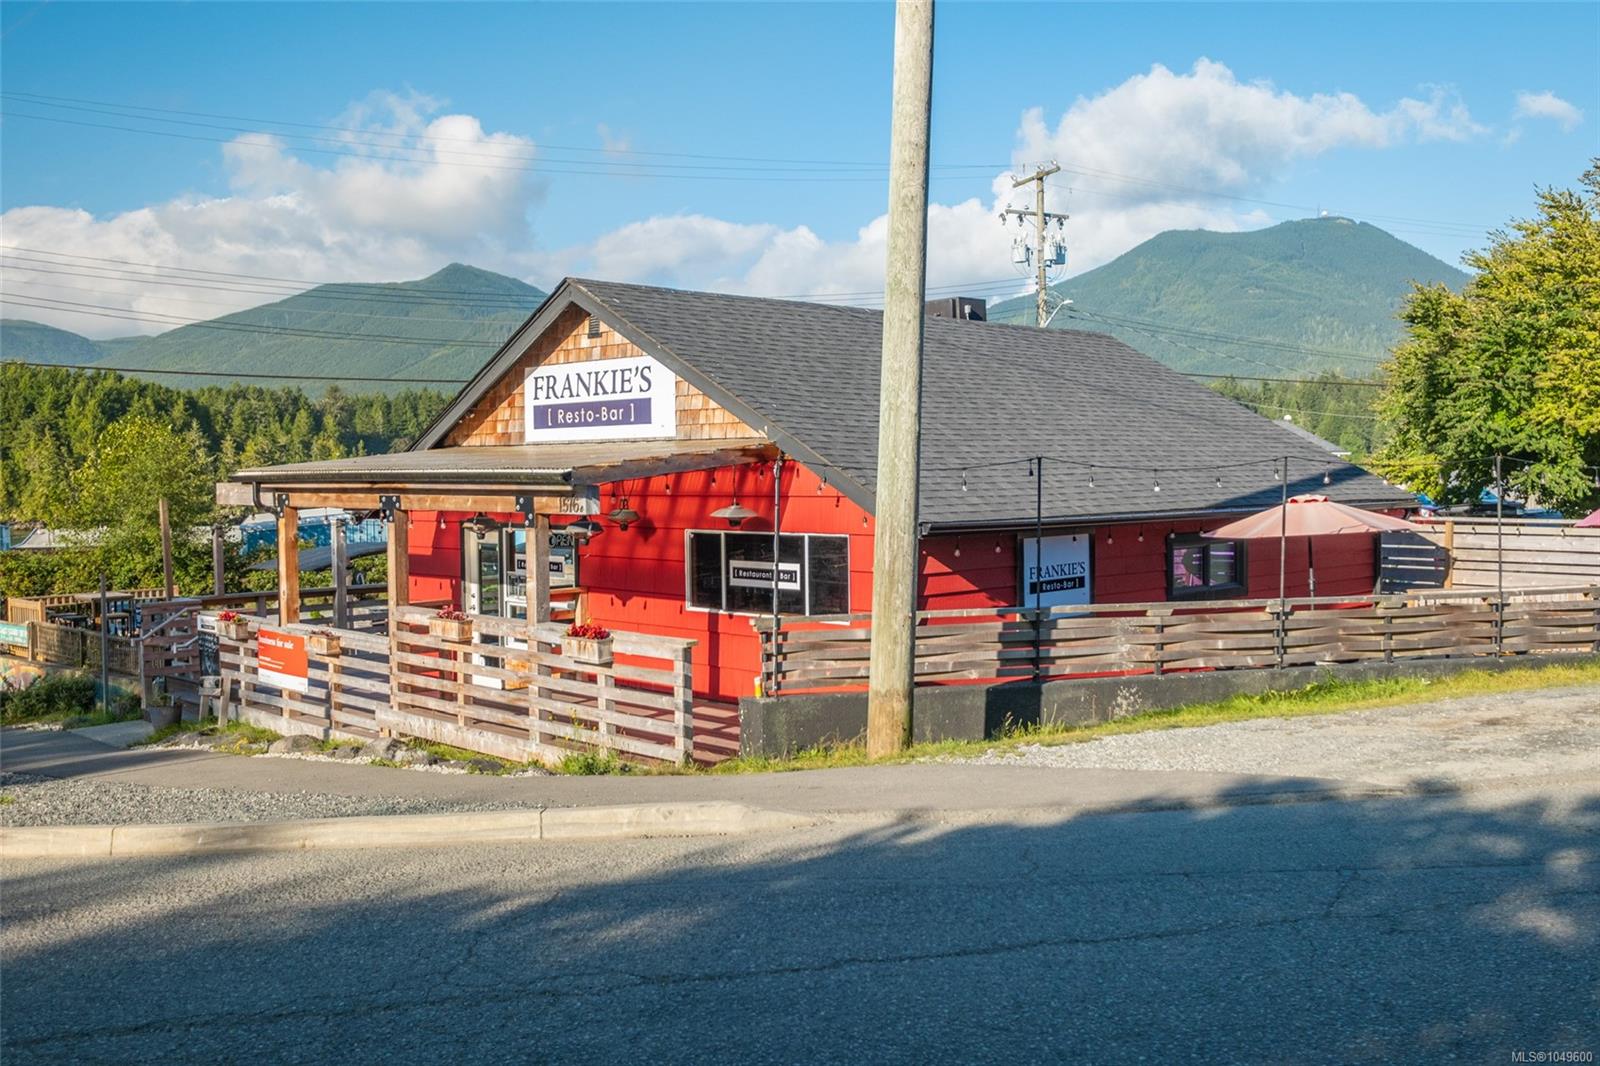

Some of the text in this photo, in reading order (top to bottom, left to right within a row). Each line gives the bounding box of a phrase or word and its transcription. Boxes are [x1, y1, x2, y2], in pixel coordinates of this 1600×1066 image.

[533, 366, 652, 401] FRANKIE'S
[557, 406, 624, 424] Resto-Bar
[1029, 561, 1086, 580] FRANKIE'S
